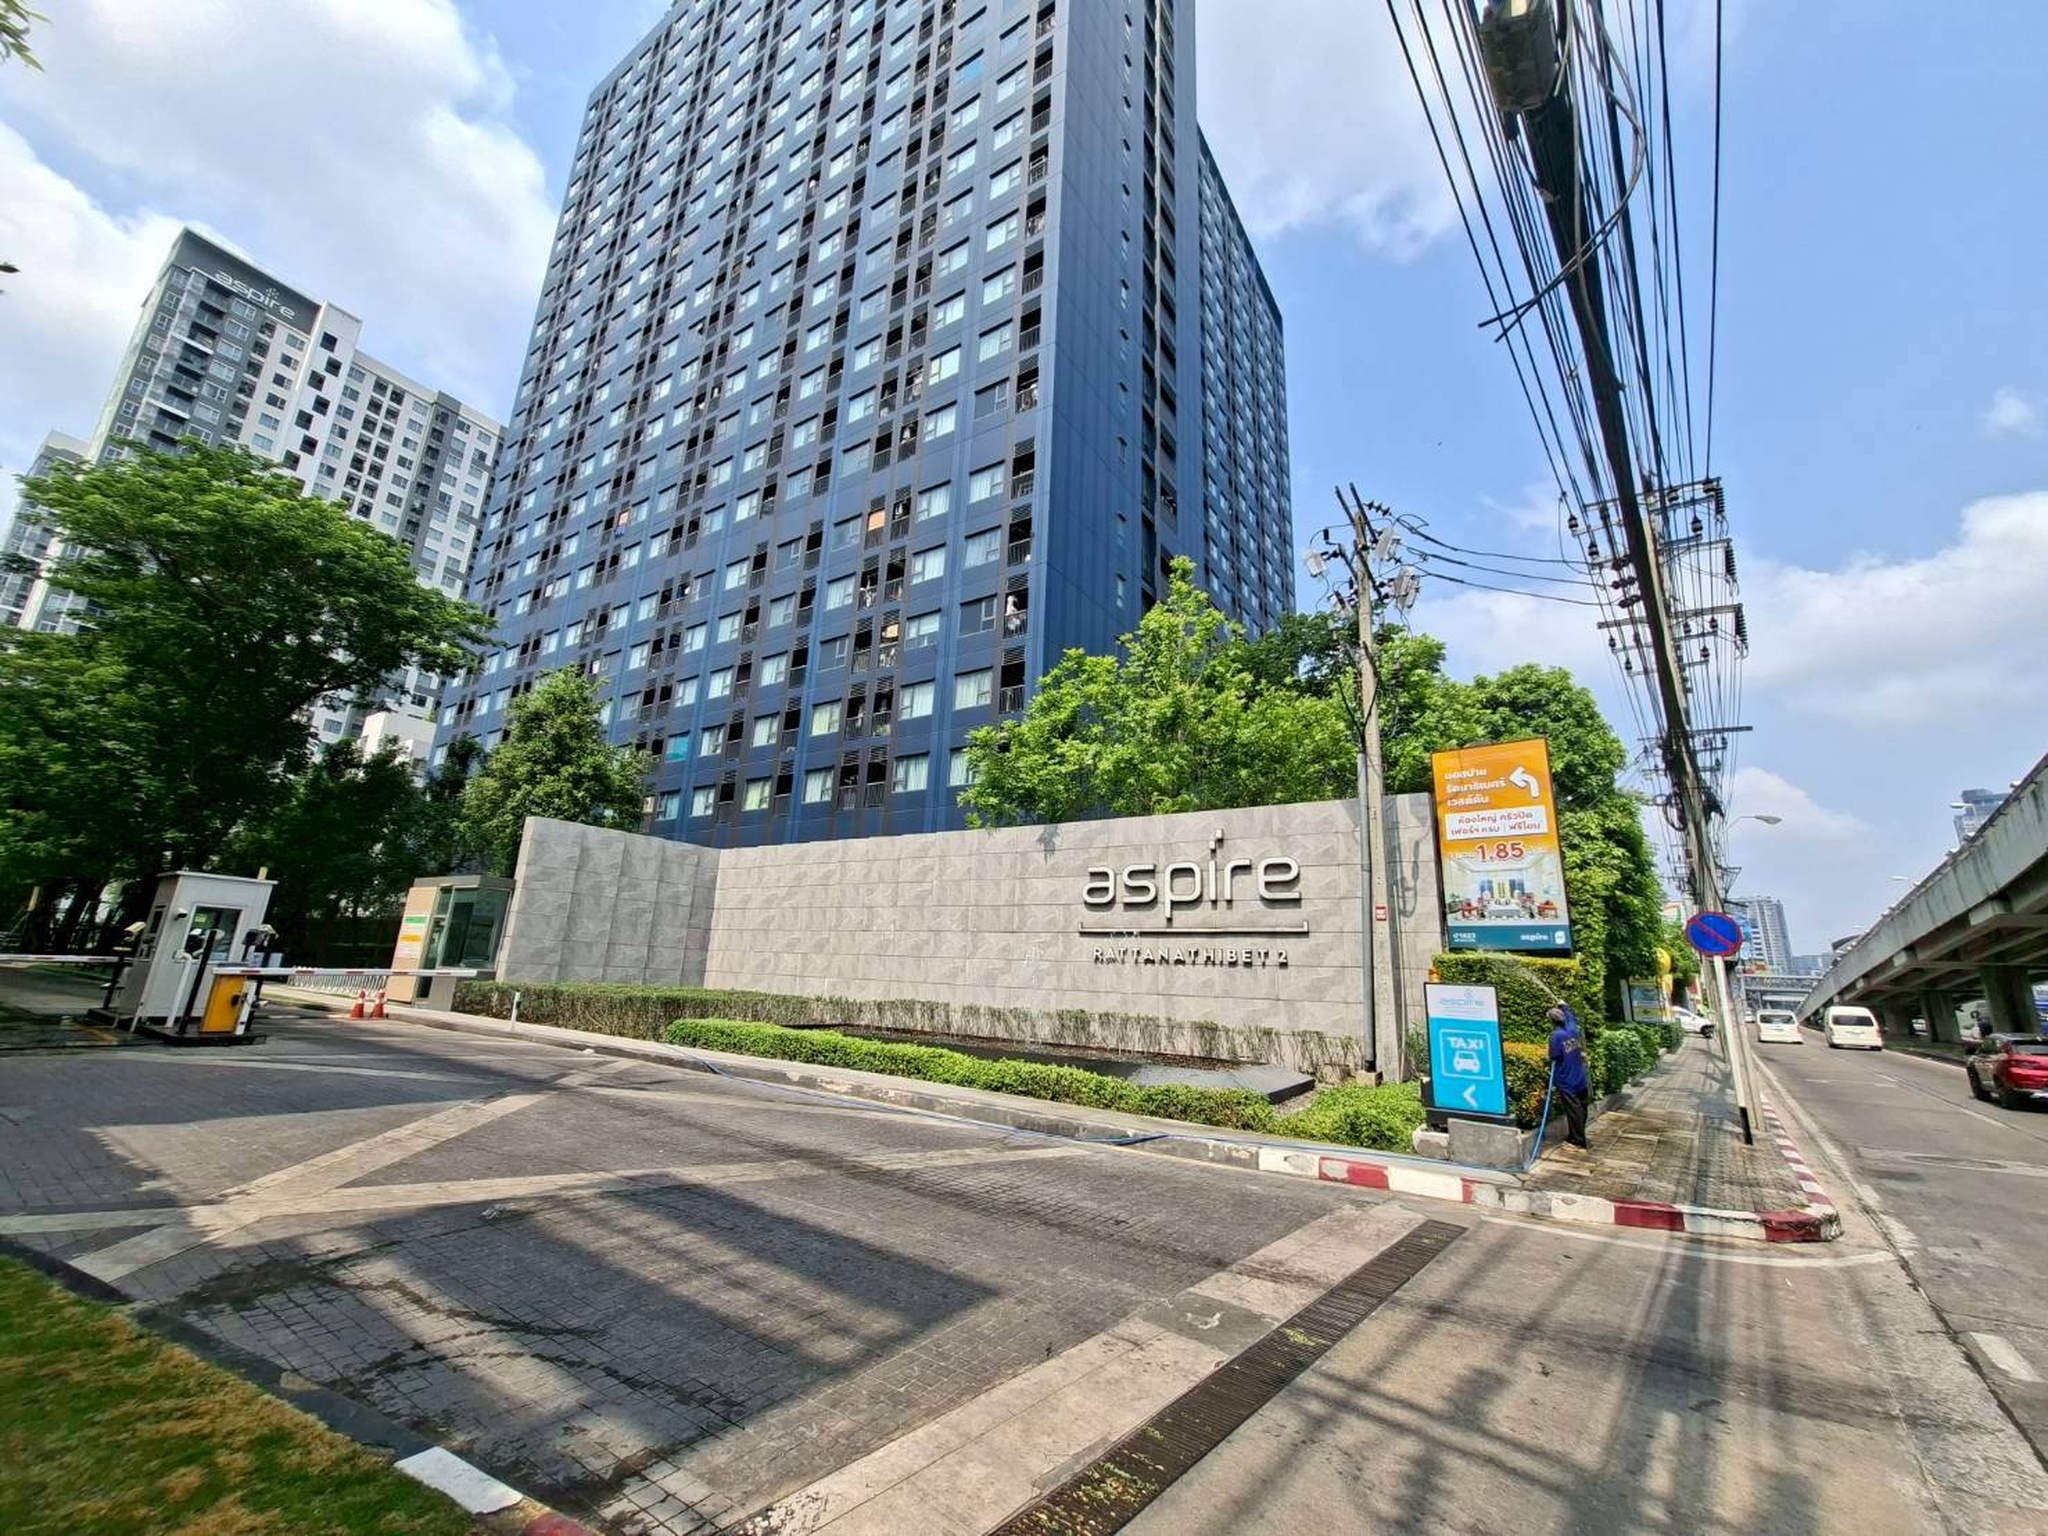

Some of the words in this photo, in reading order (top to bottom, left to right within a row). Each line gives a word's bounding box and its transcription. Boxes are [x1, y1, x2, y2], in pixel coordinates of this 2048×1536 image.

[215, 269, 296, 320] aspire
[1476, 841, 1525, 863] 1.85
[1082, 829, 1302, 919] aspire
[1094, 947, 1268, 963] RATTANATHIBET
[1277, 949, 1288, 963] 2
[1446, 1036, 1484, 1050] TAXI
